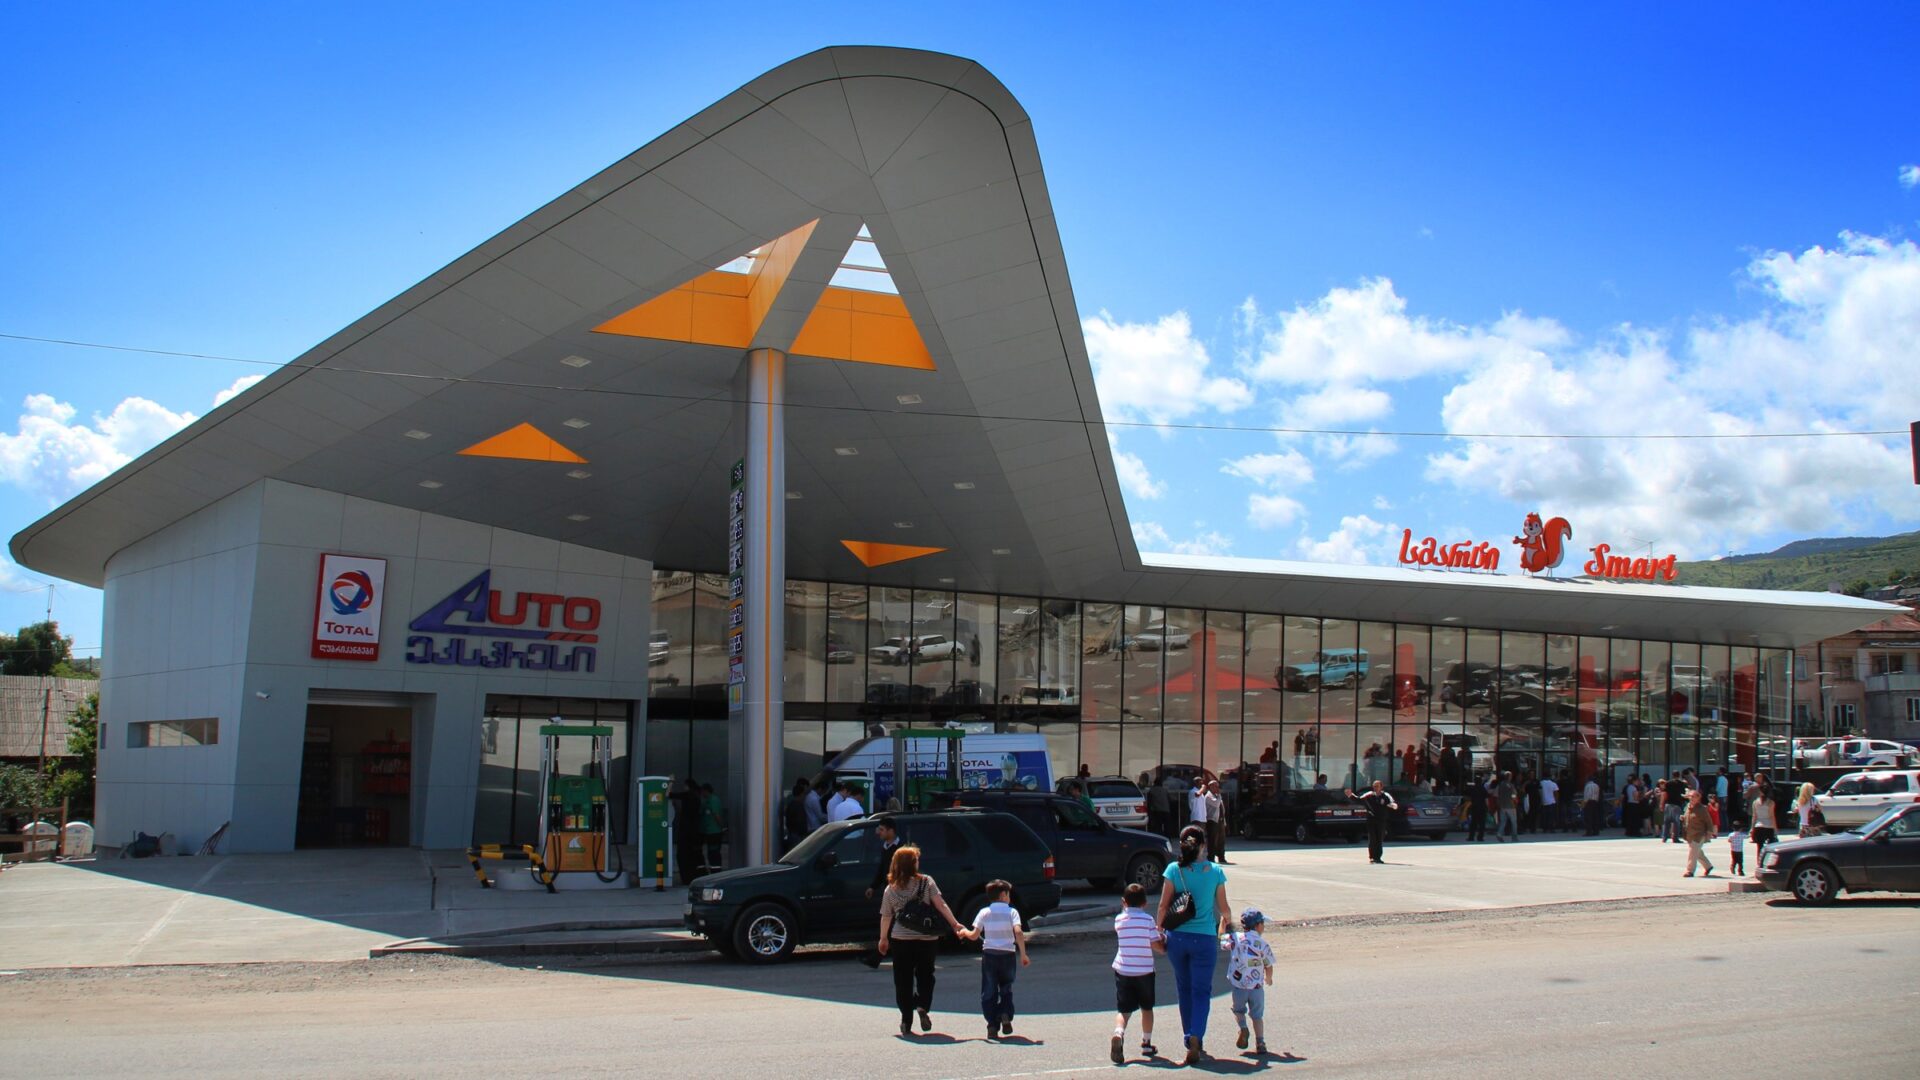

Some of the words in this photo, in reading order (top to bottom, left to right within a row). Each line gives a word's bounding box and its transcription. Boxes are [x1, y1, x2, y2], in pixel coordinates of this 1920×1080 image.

[1583, 543, 1679, 581] Smart
[324, 622, 374, 636] TOTAL
[406, 635, 597, 673] ექსპრესი
